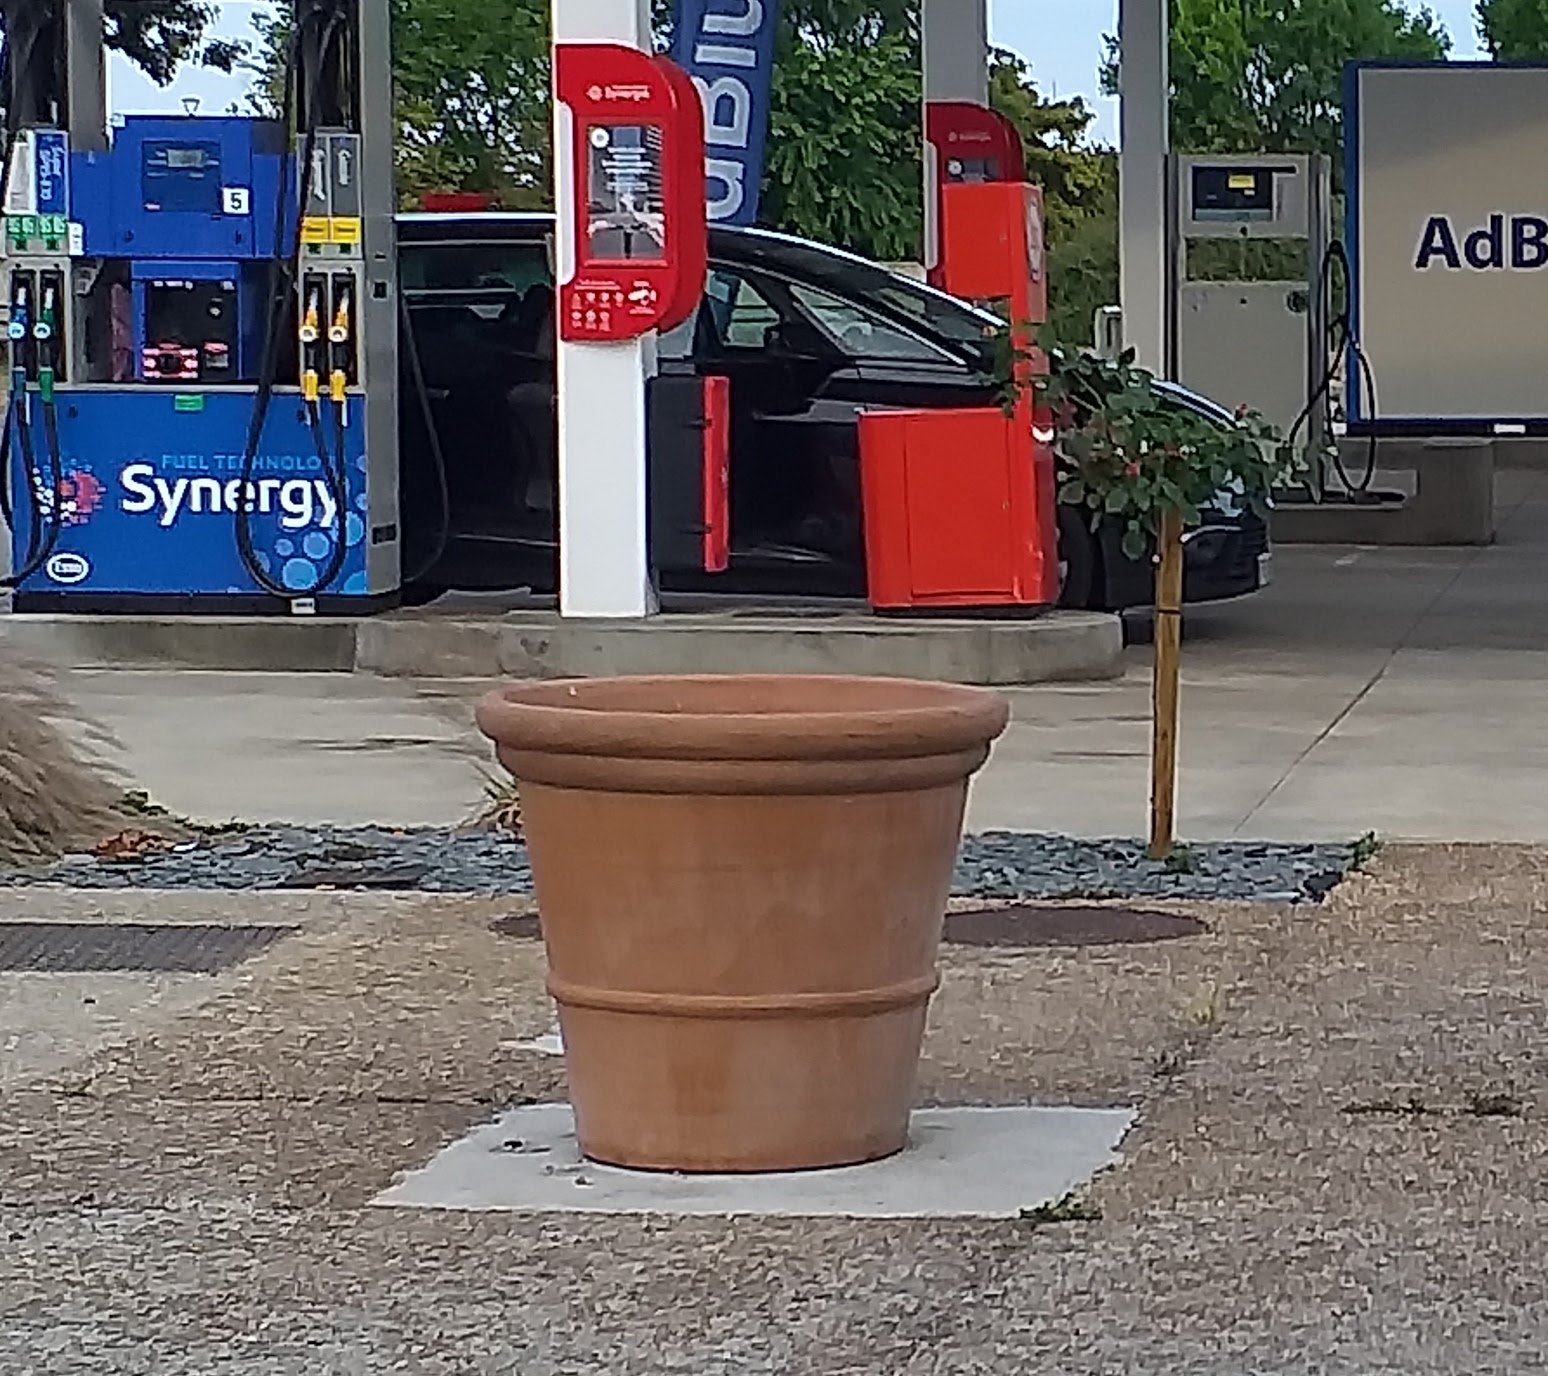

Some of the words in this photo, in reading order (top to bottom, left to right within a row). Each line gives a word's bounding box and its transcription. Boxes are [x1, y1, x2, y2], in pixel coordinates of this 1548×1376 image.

[230, 192, 243, 210] 5
[161, 454, 210, 471] FUEL
[120, 462, 339, 528] Synergy
